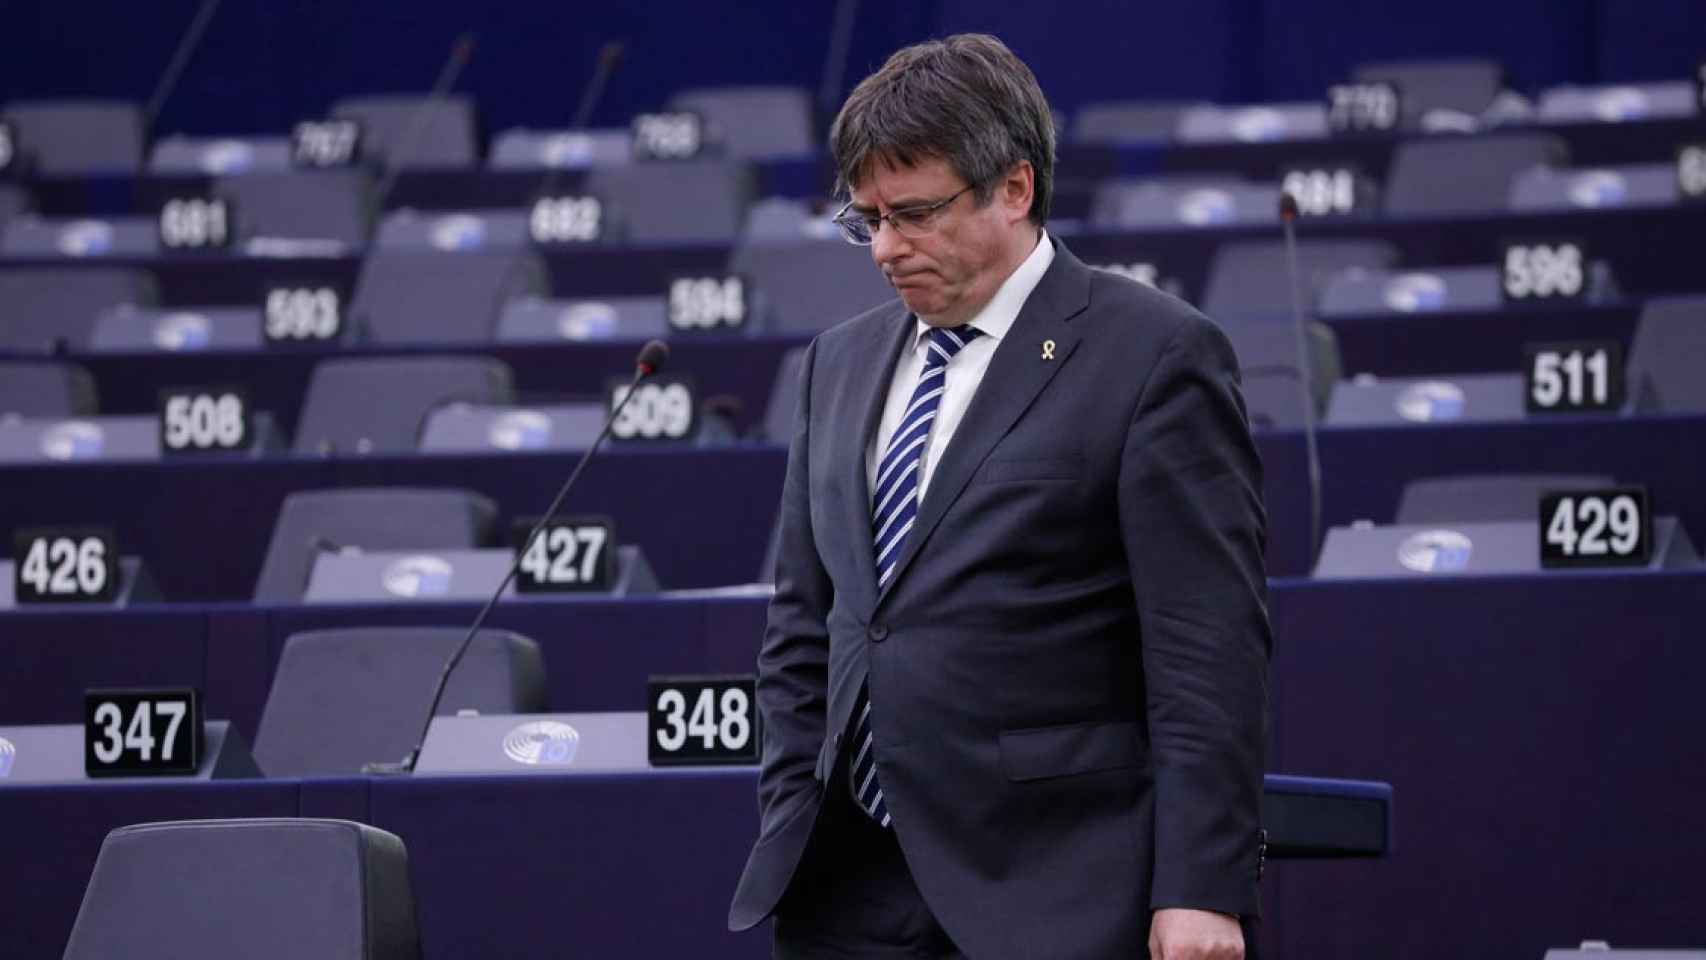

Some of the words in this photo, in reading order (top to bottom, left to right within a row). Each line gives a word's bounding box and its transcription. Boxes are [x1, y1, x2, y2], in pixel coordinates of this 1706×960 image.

[1505, 243, 1582, 297] 596
[266, 288, 339, 339] 593
[670, 277, 744, 328] 594
[1532, 350, 1607, 407] 511
[164, 393, 244, 449] 508
[612, 384, 692, 438] 509
[1546, 495, 1639, 556] 429
[20, 537, 106, 594] 426
[519, 527, 606, 583] 427
[93, 701, 187, 764] 347
[656, 687, 751, 752] 348
